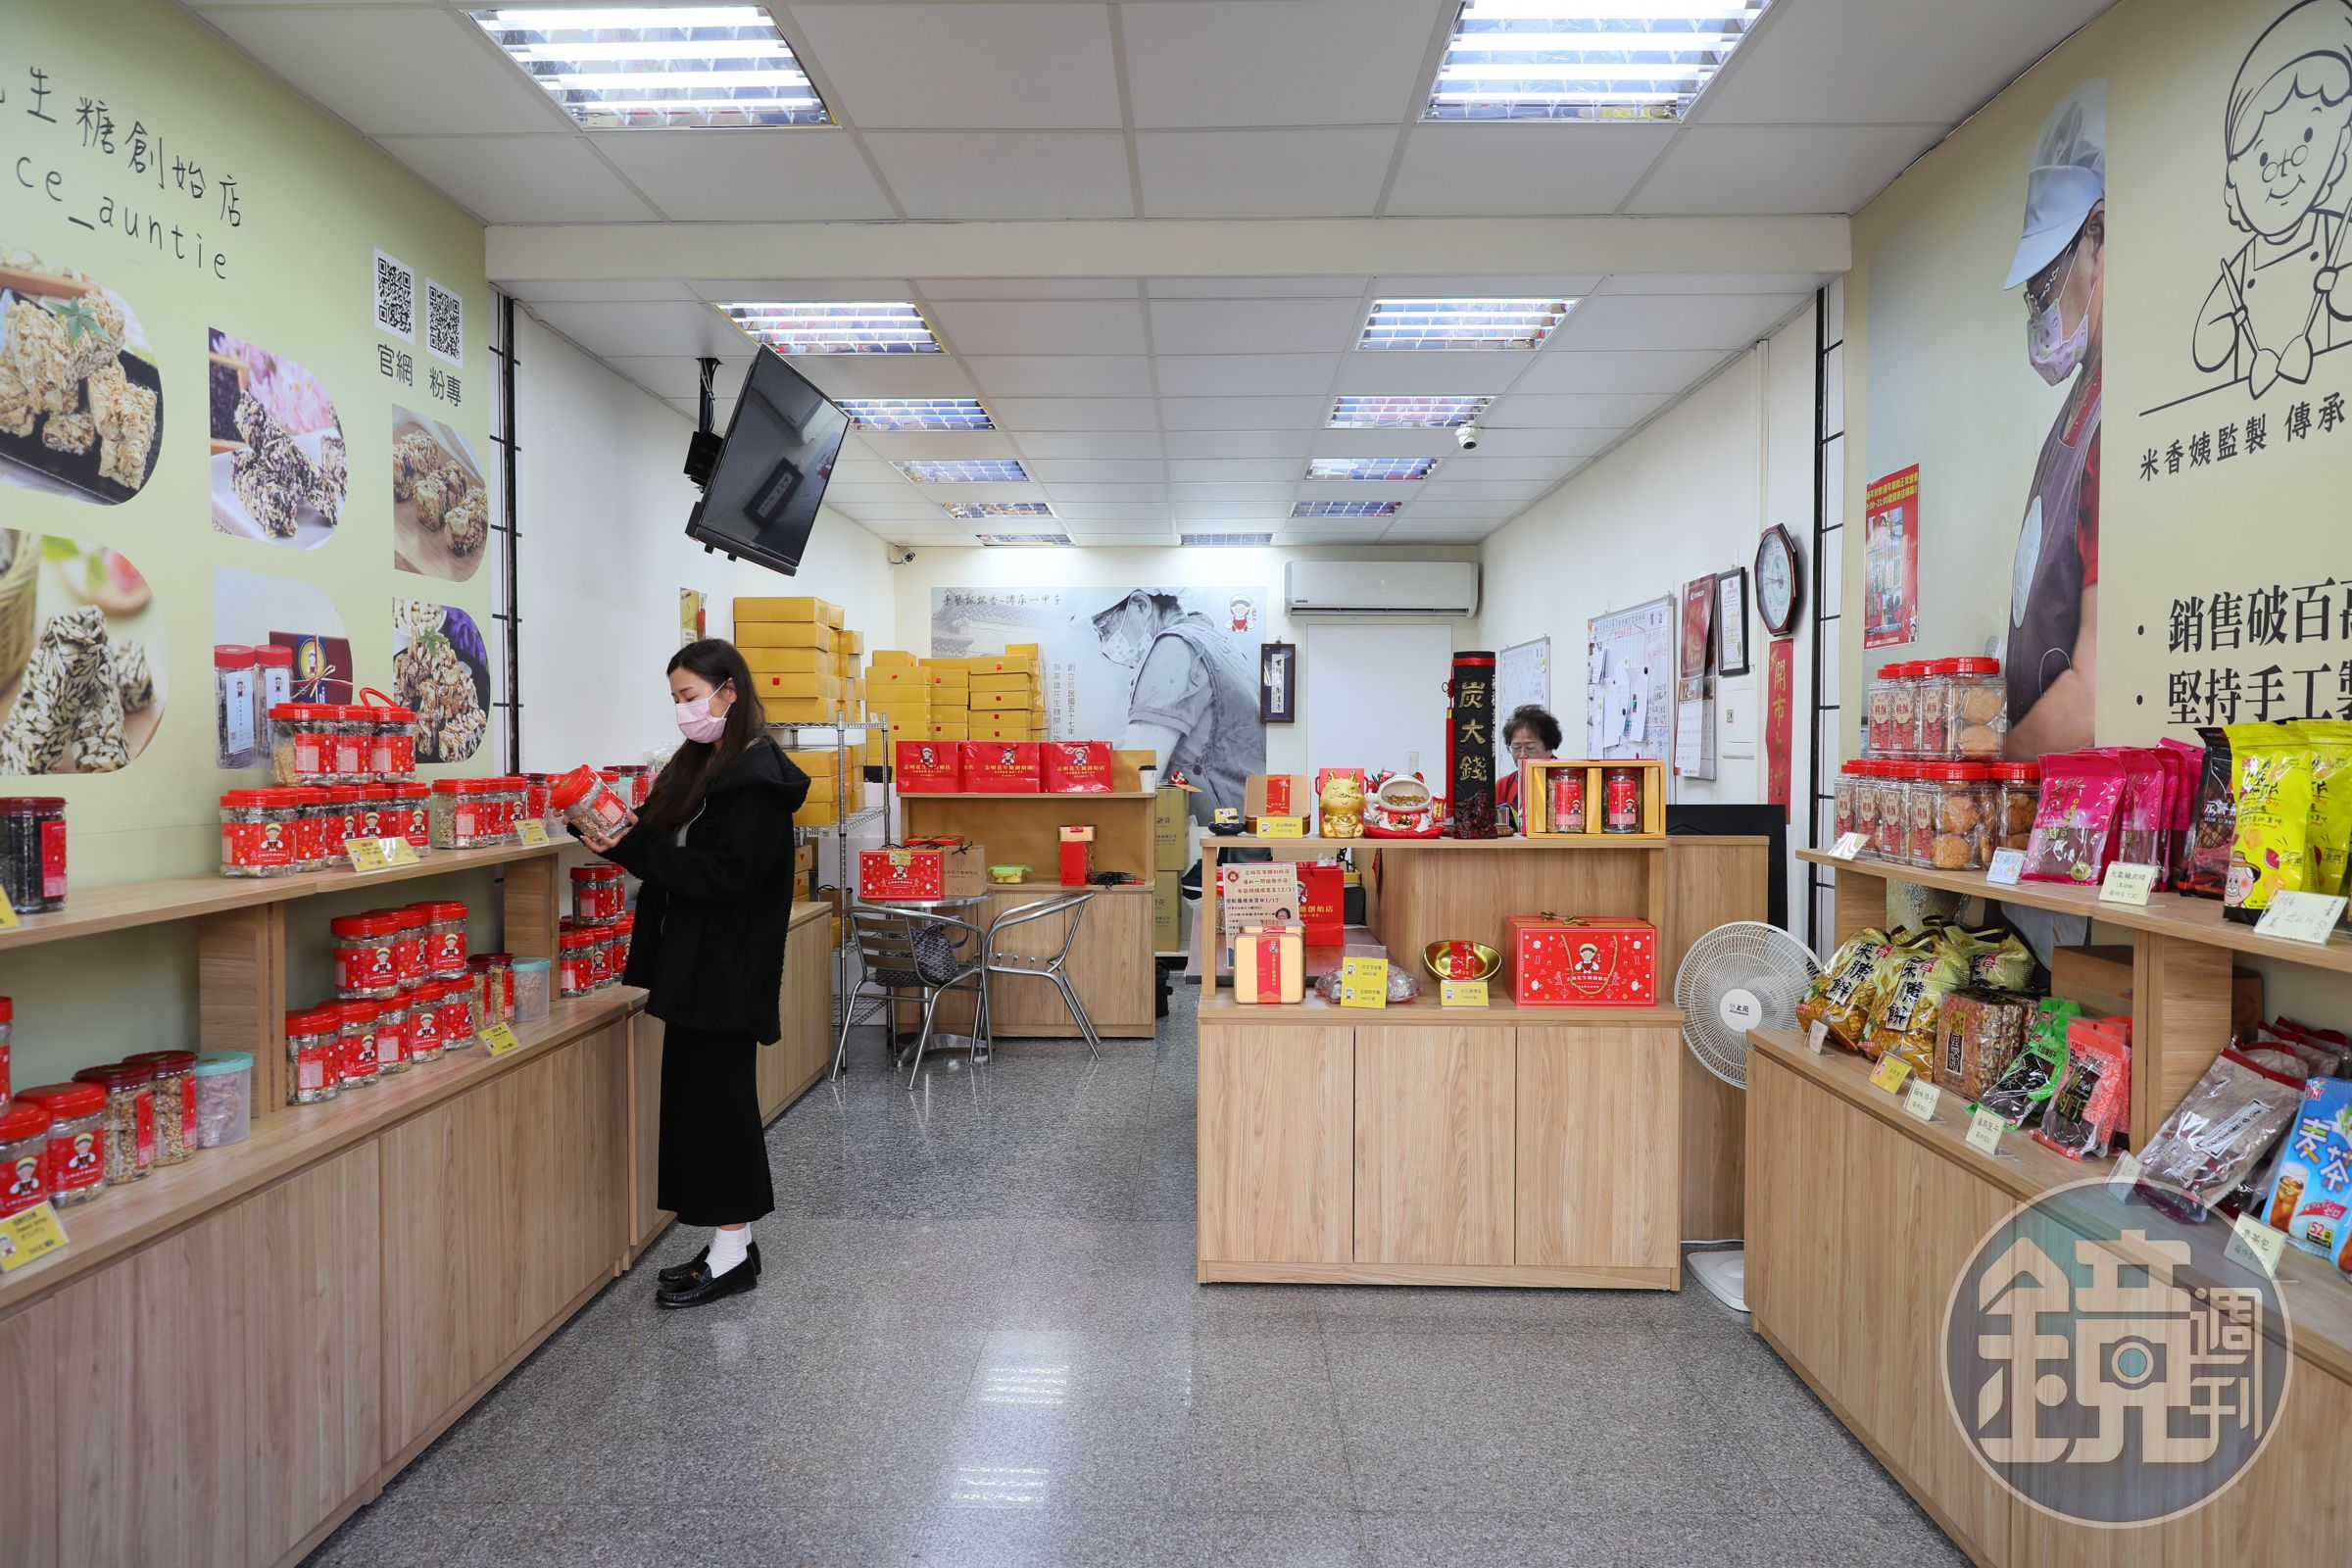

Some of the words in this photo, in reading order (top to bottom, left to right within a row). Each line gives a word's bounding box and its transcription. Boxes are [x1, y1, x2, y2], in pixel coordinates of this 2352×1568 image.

[0, 67, 241, 227] 生糖創始店
[377, 343, 413, 387] 官網
[429, 366, 462, 408] 粉專
[2139, 413, 2268, 482] 米香姨監製
[2284, 391, 2346, 443] 傳承
[1458, 681, 1488, 782] 炭大錢
